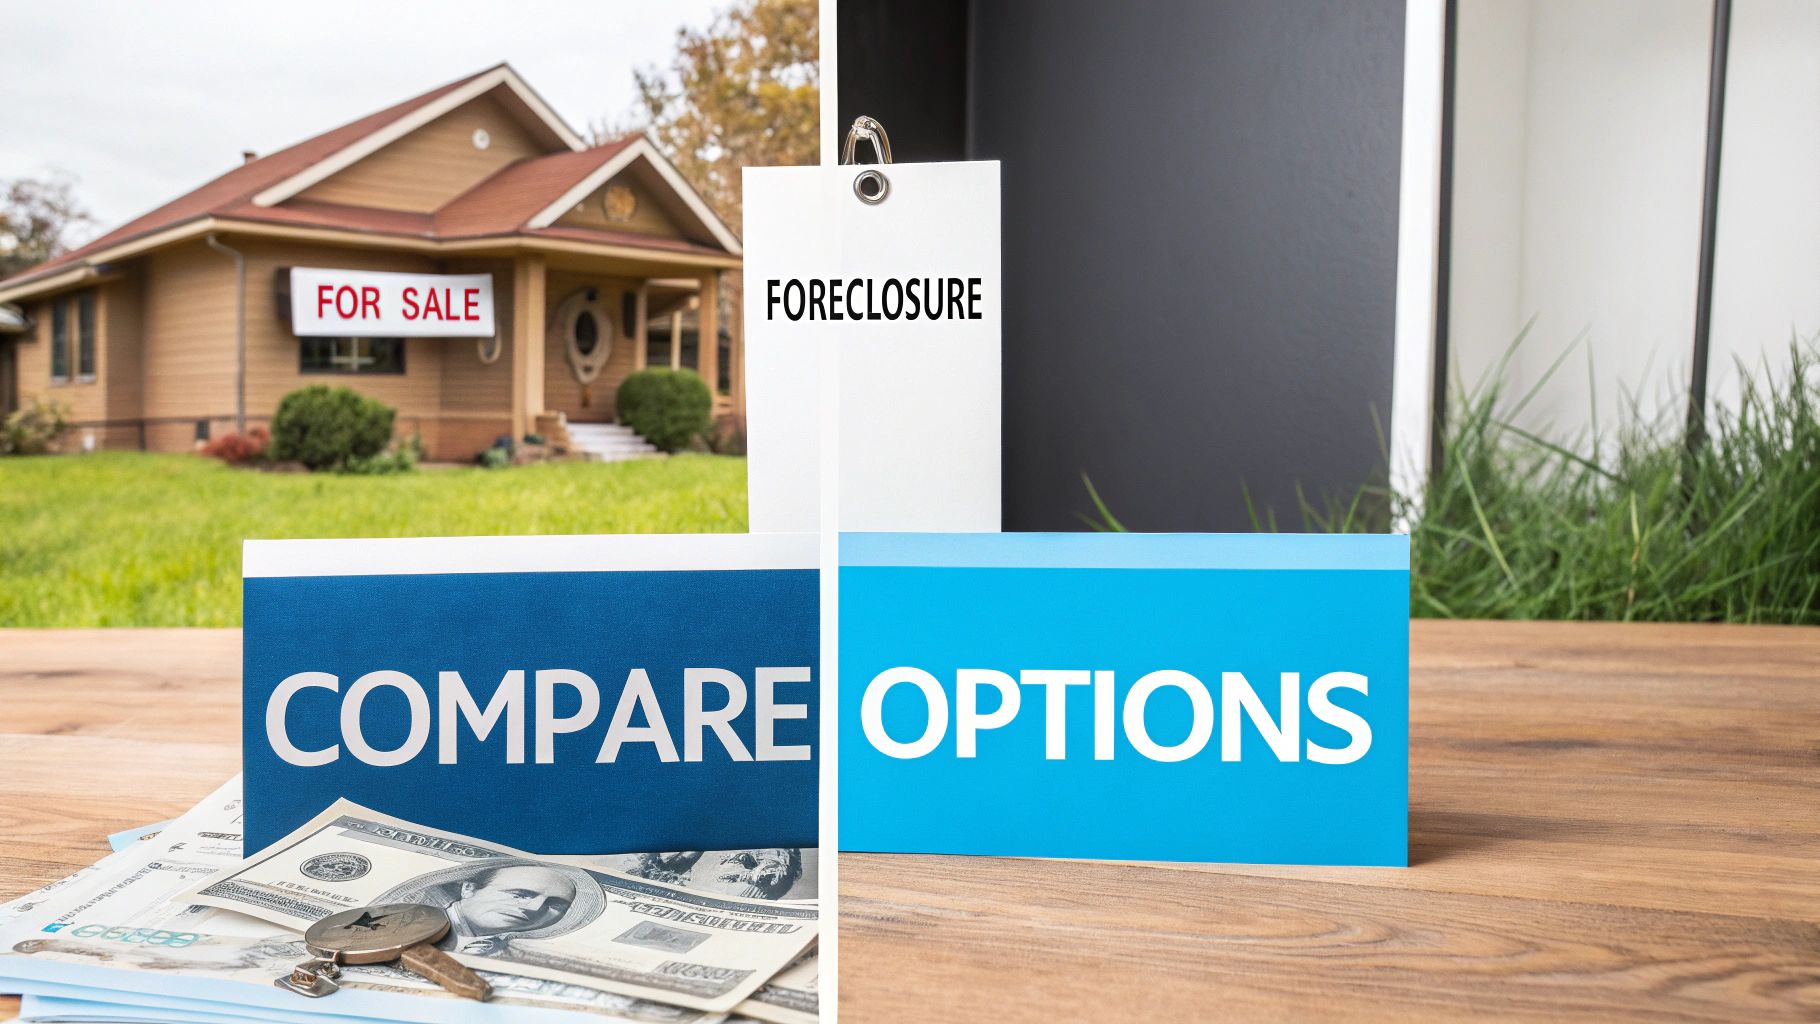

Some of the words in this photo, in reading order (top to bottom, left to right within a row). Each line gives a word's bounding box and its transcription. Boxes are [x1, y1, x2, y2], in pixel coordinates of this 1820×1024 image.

[317, 284, 381, 320] FOR
[401, 287, 481, 322] SALE
[767, 277, 983, 322] FORECLOSURE
[265, 666, 811, 767] COMPARE
[860, 667, 1373, 765] OPTIONS
